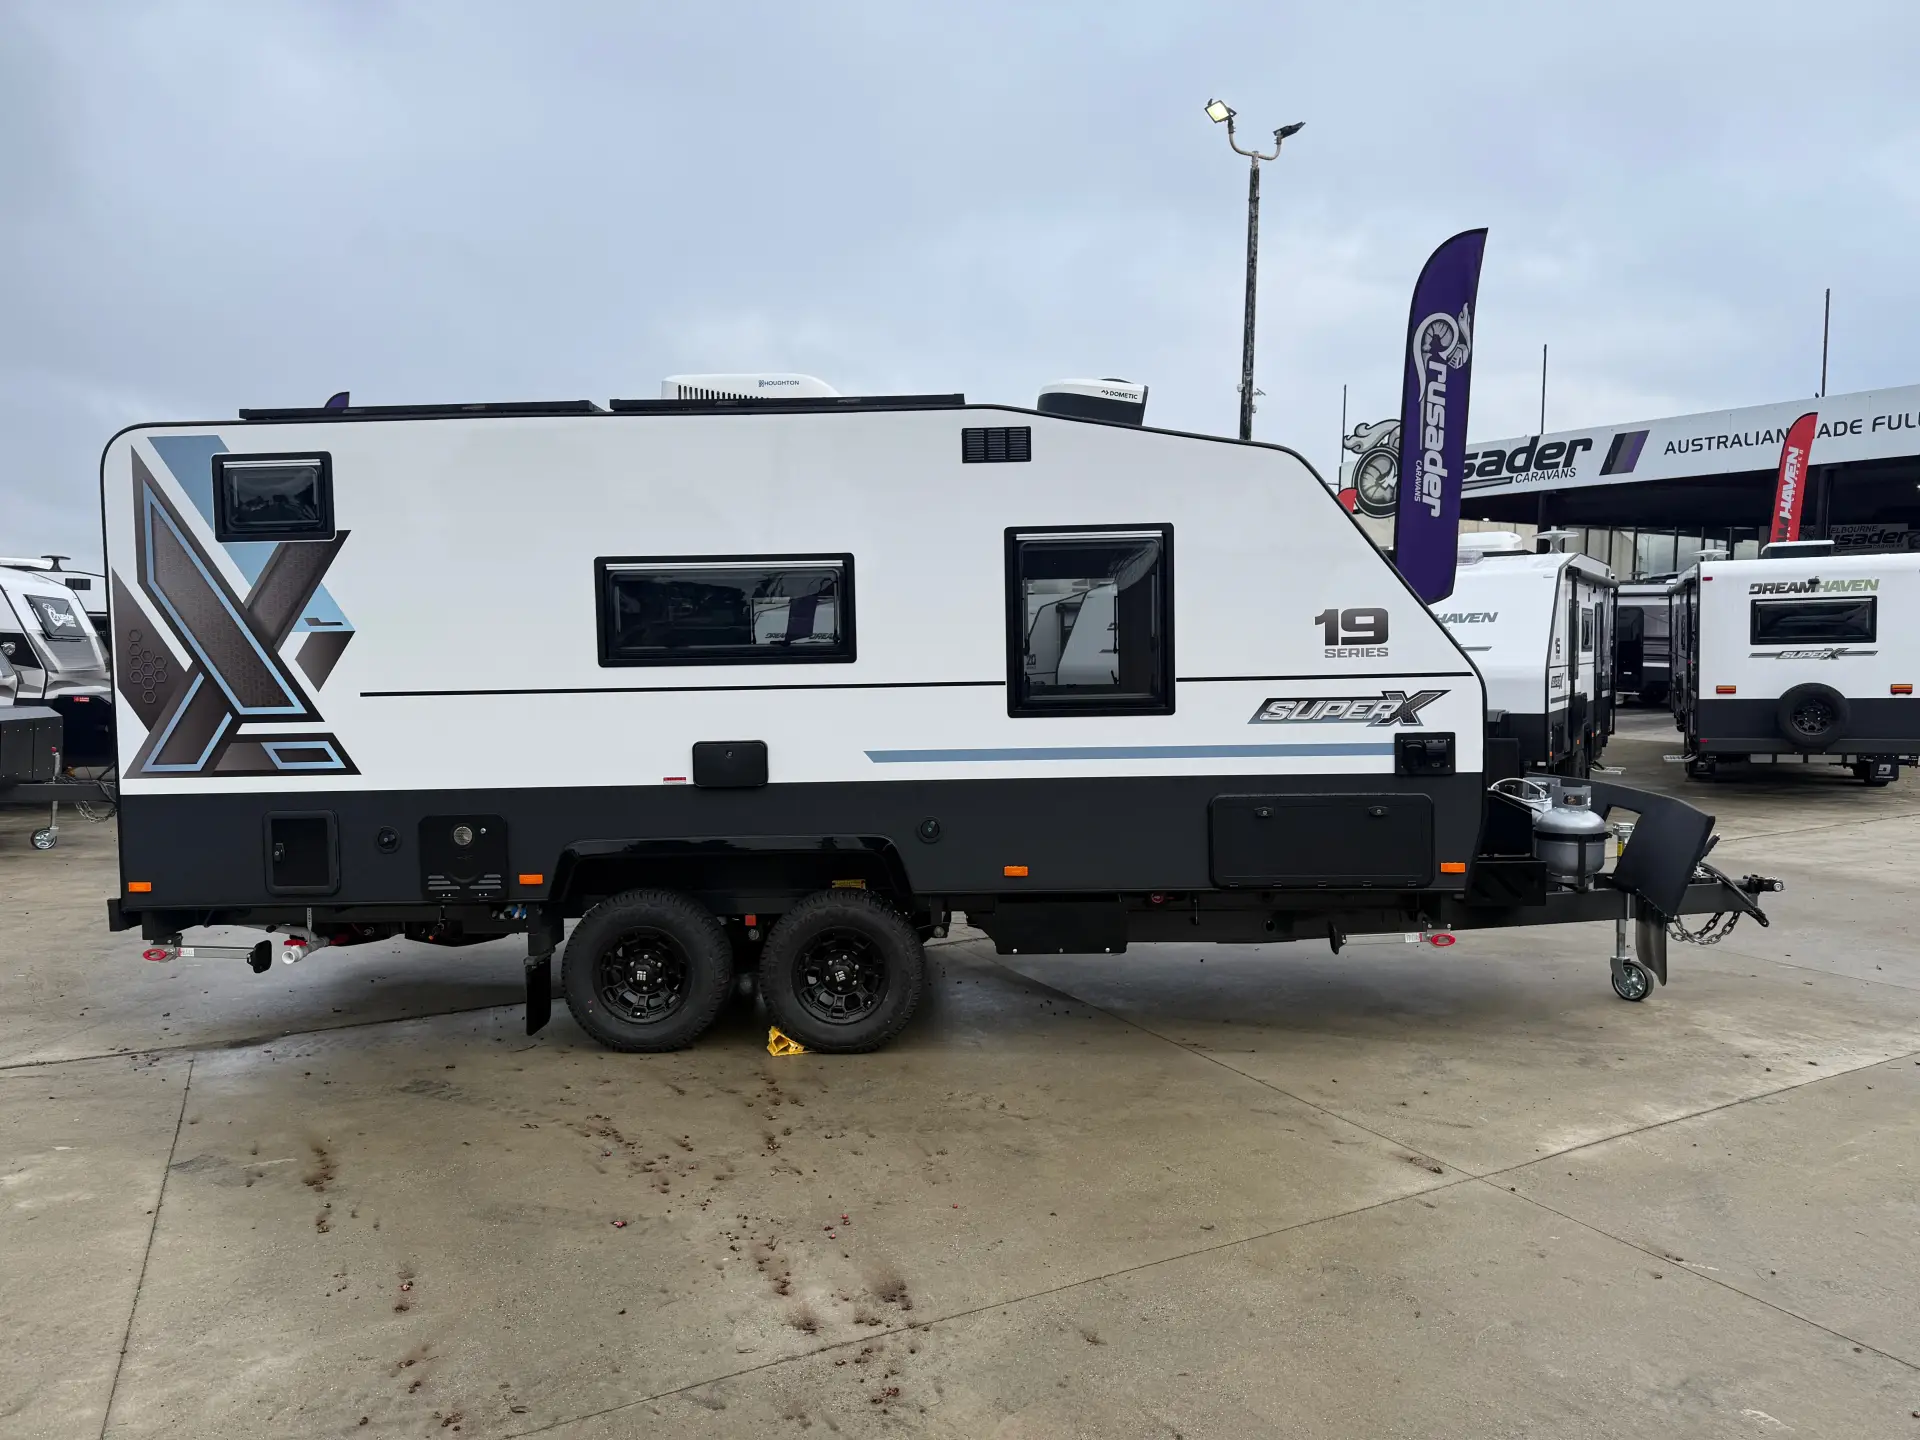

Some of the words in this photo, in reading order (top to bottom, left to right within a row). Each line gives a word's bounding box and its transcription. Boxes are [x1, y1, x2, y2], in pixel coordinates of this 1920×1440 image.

[1110, 390, 1138, 399] DOMETIC
[1413, 312, 1459, 518] Crusader
[1664, 427, 1790, 455] AUSTRALIAN
[1816, 418, 1863, 439] ADE
[1463, 435, 1594, 479] sader
[1414, 460, 1422, 502] CARAVANS
[1515, 468, 1577, 484] CARAVANS
[1779, 446, 1798, 519] HAVEN
[1830, 524, 1878, 534] ELBOURNE
[1834, 529, 1910, 546] sader
[1315, 607, 1389, 646] 19
[1434, 612, 1499, 624] HAVEN
[1325, 647, 1389, 659] SERIES
